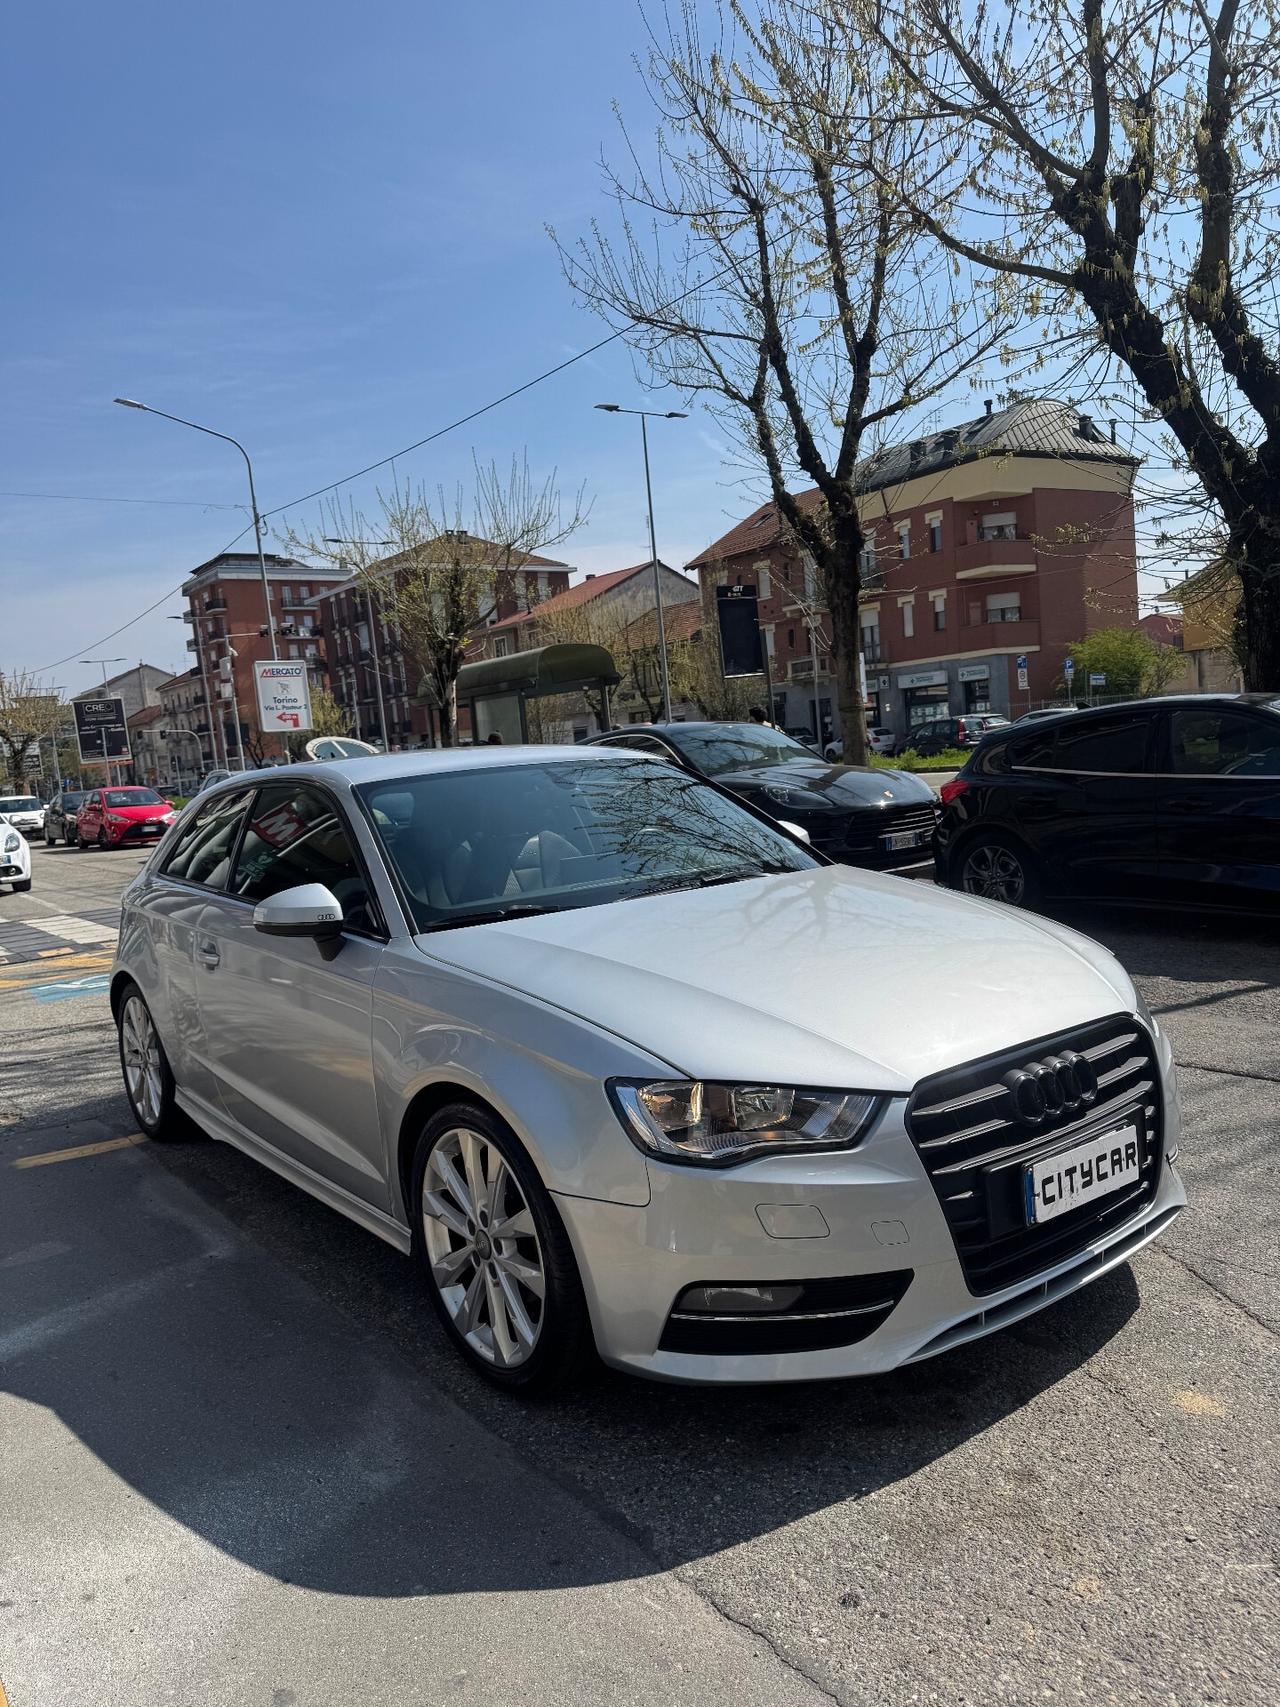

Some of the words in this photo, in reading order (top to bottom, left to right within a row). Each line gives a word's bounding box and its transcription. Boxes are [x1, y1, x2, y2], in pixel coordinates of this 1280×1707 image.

[1066, 660, 1072, 668] P
[260, 667, 302, 678] MERCATO
[272, 696, 298, 704] Torino
[85, 702, 113, 712] CREO
[1041, 1141, 1137, 1206] CITYCAR
